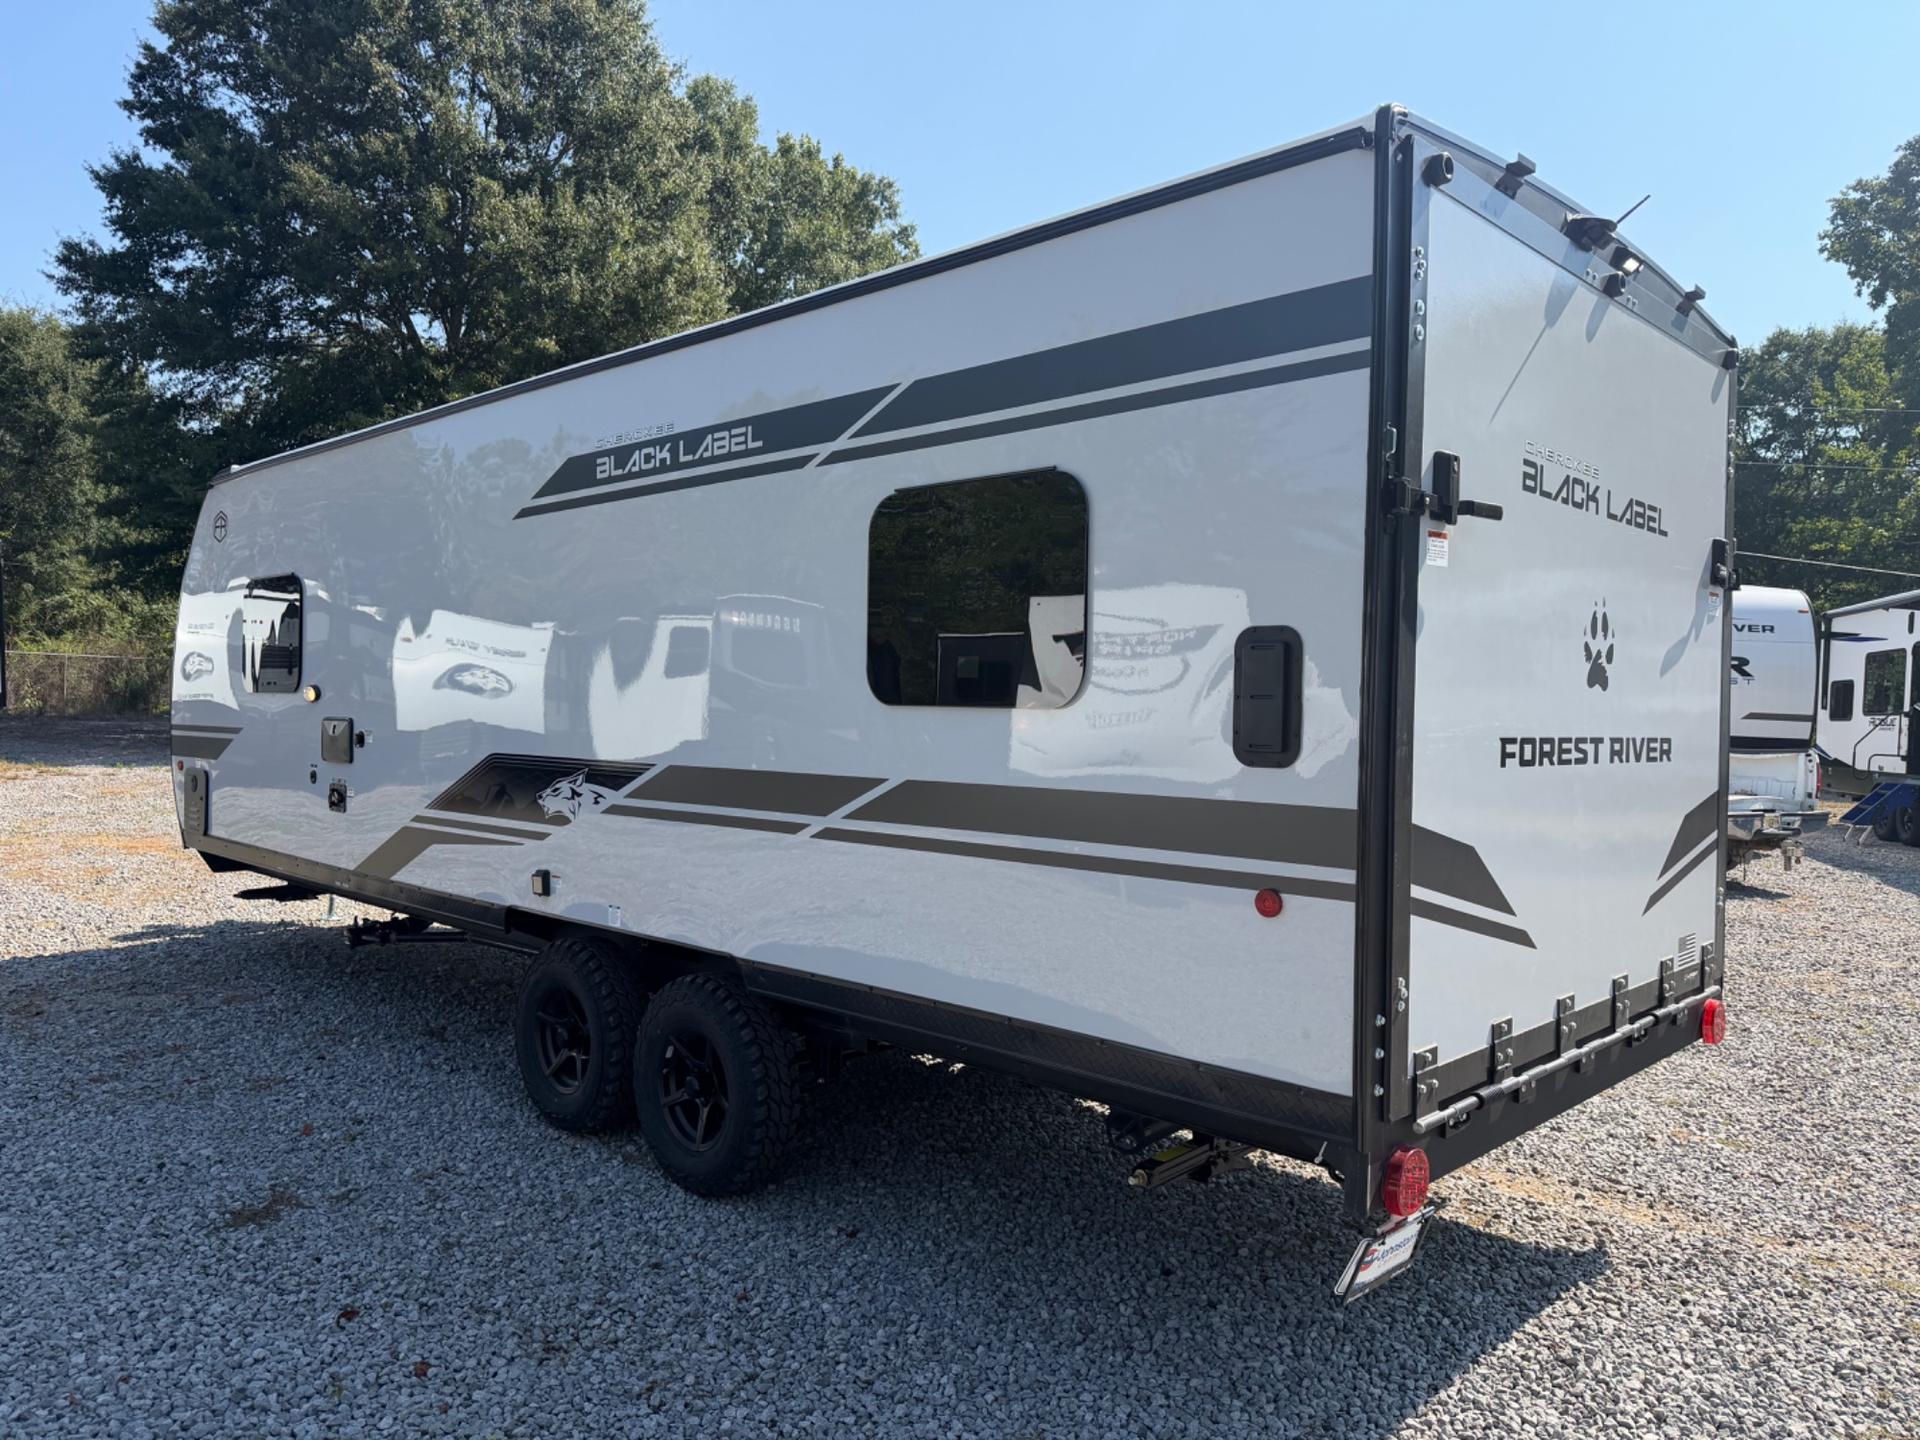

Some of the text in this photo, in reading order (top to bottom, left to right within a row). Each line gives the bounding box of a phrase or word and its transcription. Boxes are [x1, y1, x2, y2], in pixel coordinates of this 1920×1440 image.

[594, 422, 675, 449] CHEROKEE
[596, 425, 763, 480] BLACK LABEL
[1524, 439, 1601, 479] CHEROKEE
[1522, 457, 1669, 538] BLACK LABEL
[1499, 737, 1672, 769] FOREST RIVER
